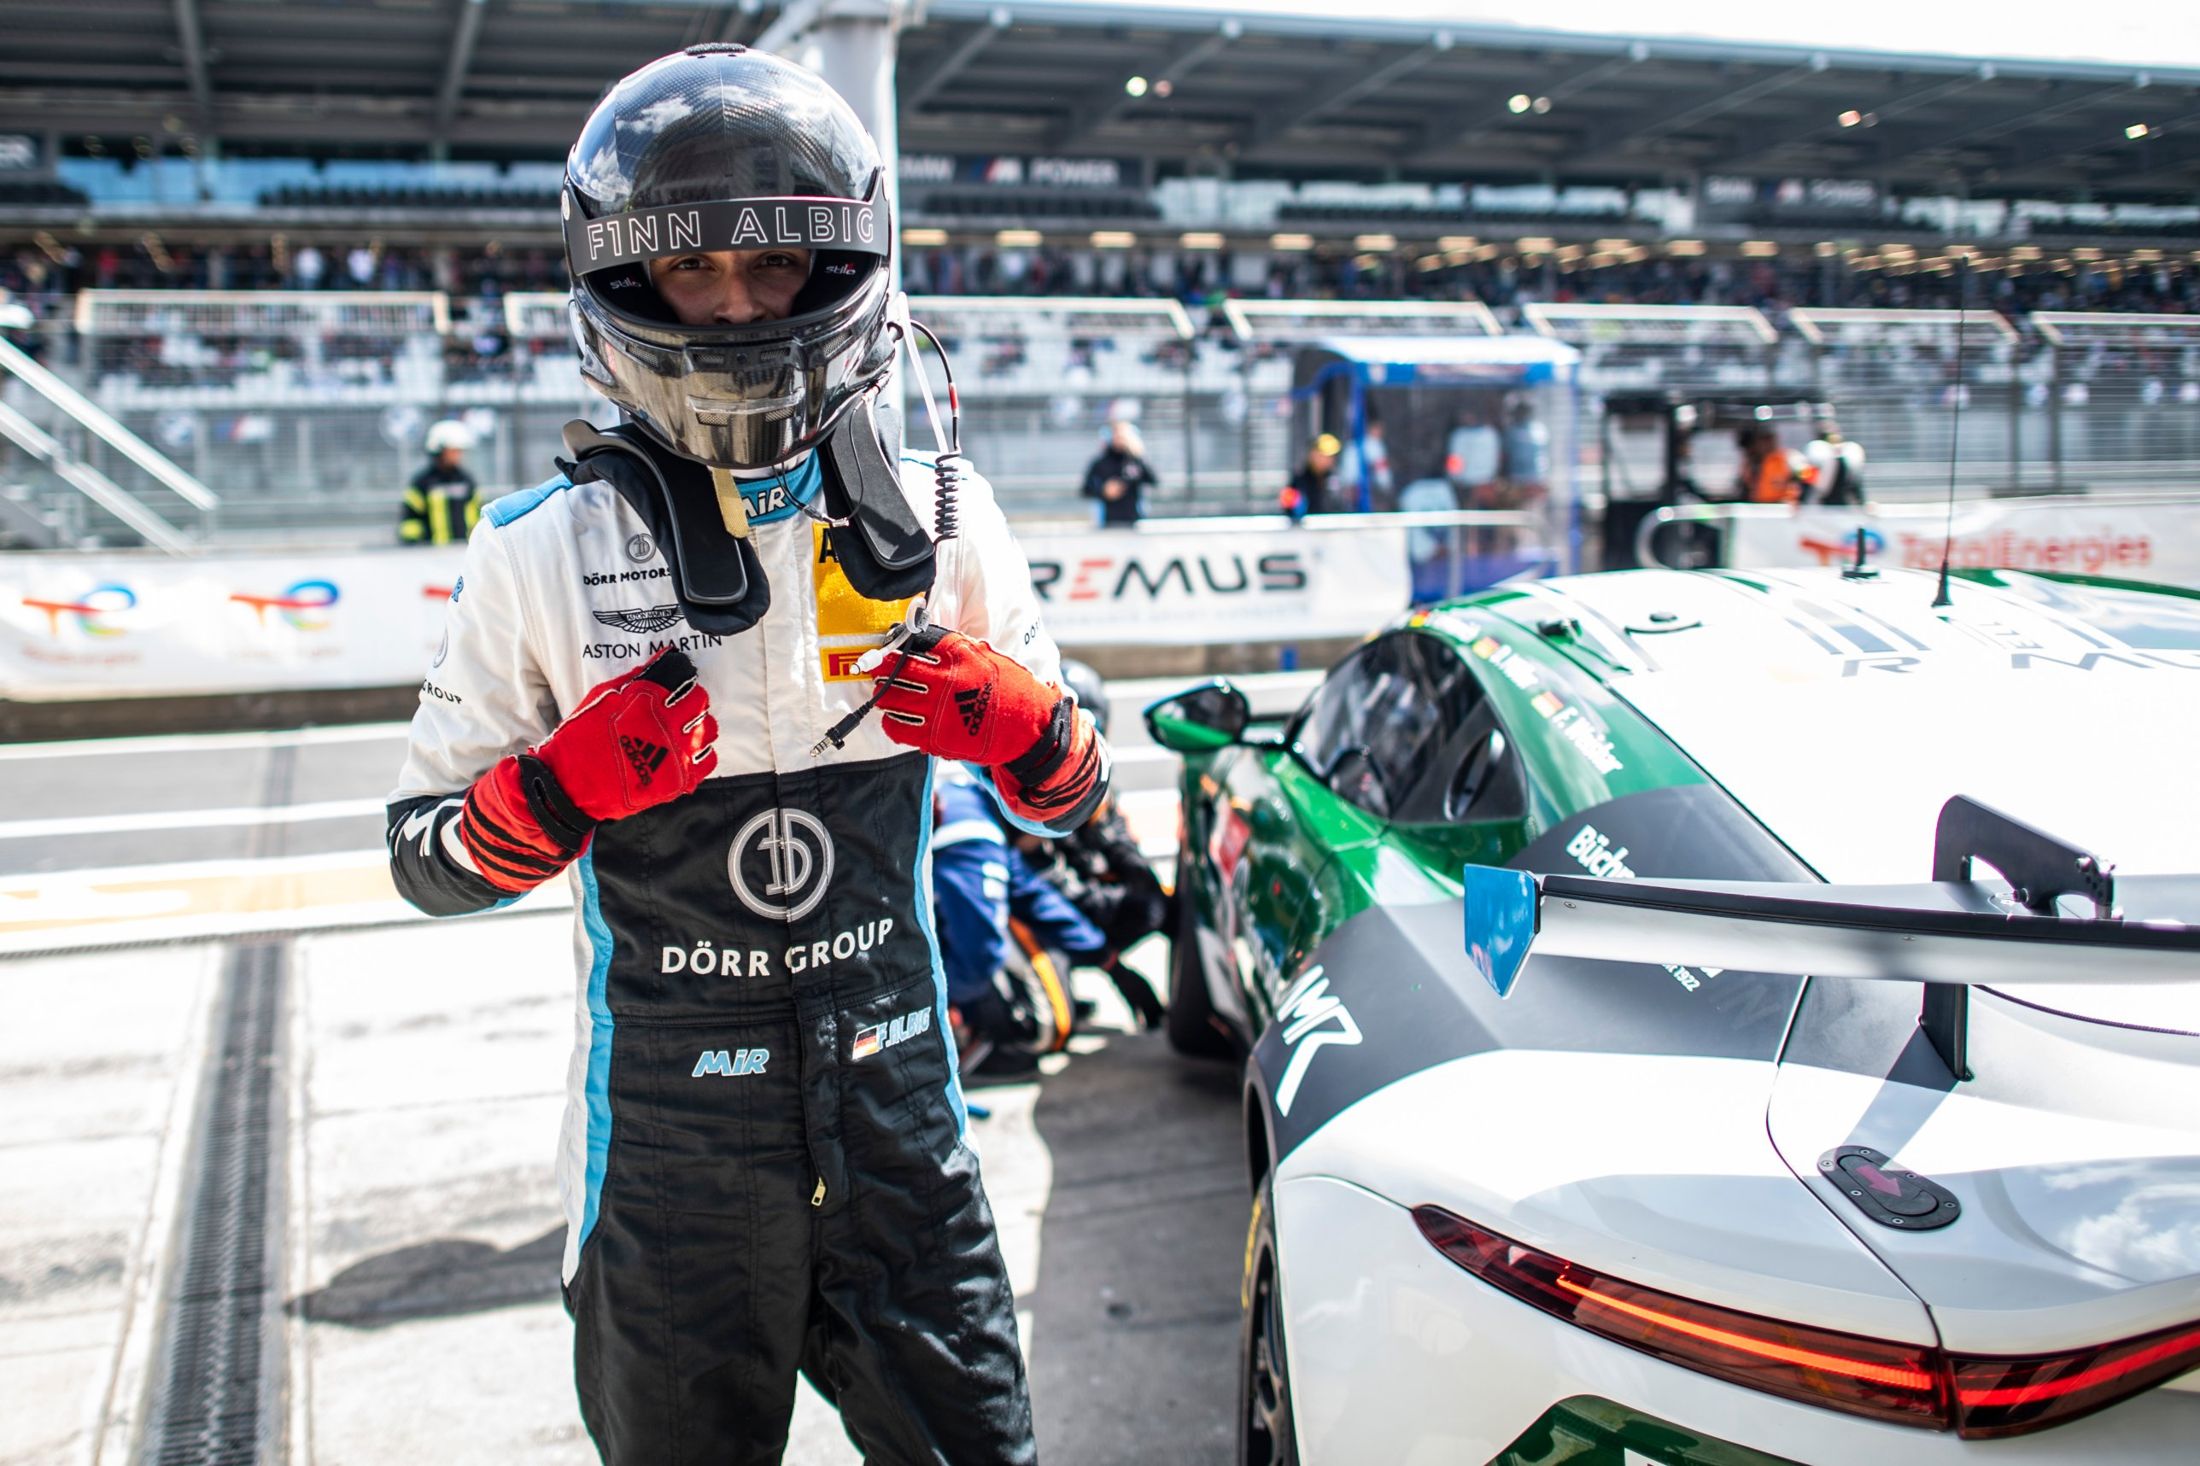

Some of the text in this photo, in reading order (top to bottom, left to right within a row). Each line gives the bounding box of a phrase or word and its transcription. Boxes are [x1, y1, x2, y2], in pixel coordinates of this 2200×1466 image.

[1031, 157, 1119, 184] POWER
[731, 205, 874, 245] ALBIG
[583, 572, 617, 586] DÖRR
[1029, 553, 1307, 601] REMUS
[582, 643, 641, 659] ASTON
[968, 682, 992, 737] adidas
[619, 735, 653, 786] adidas
[661, 917, 893, 977] DÖRR GROUP
[1674, 965, 1701, 992] 1922
